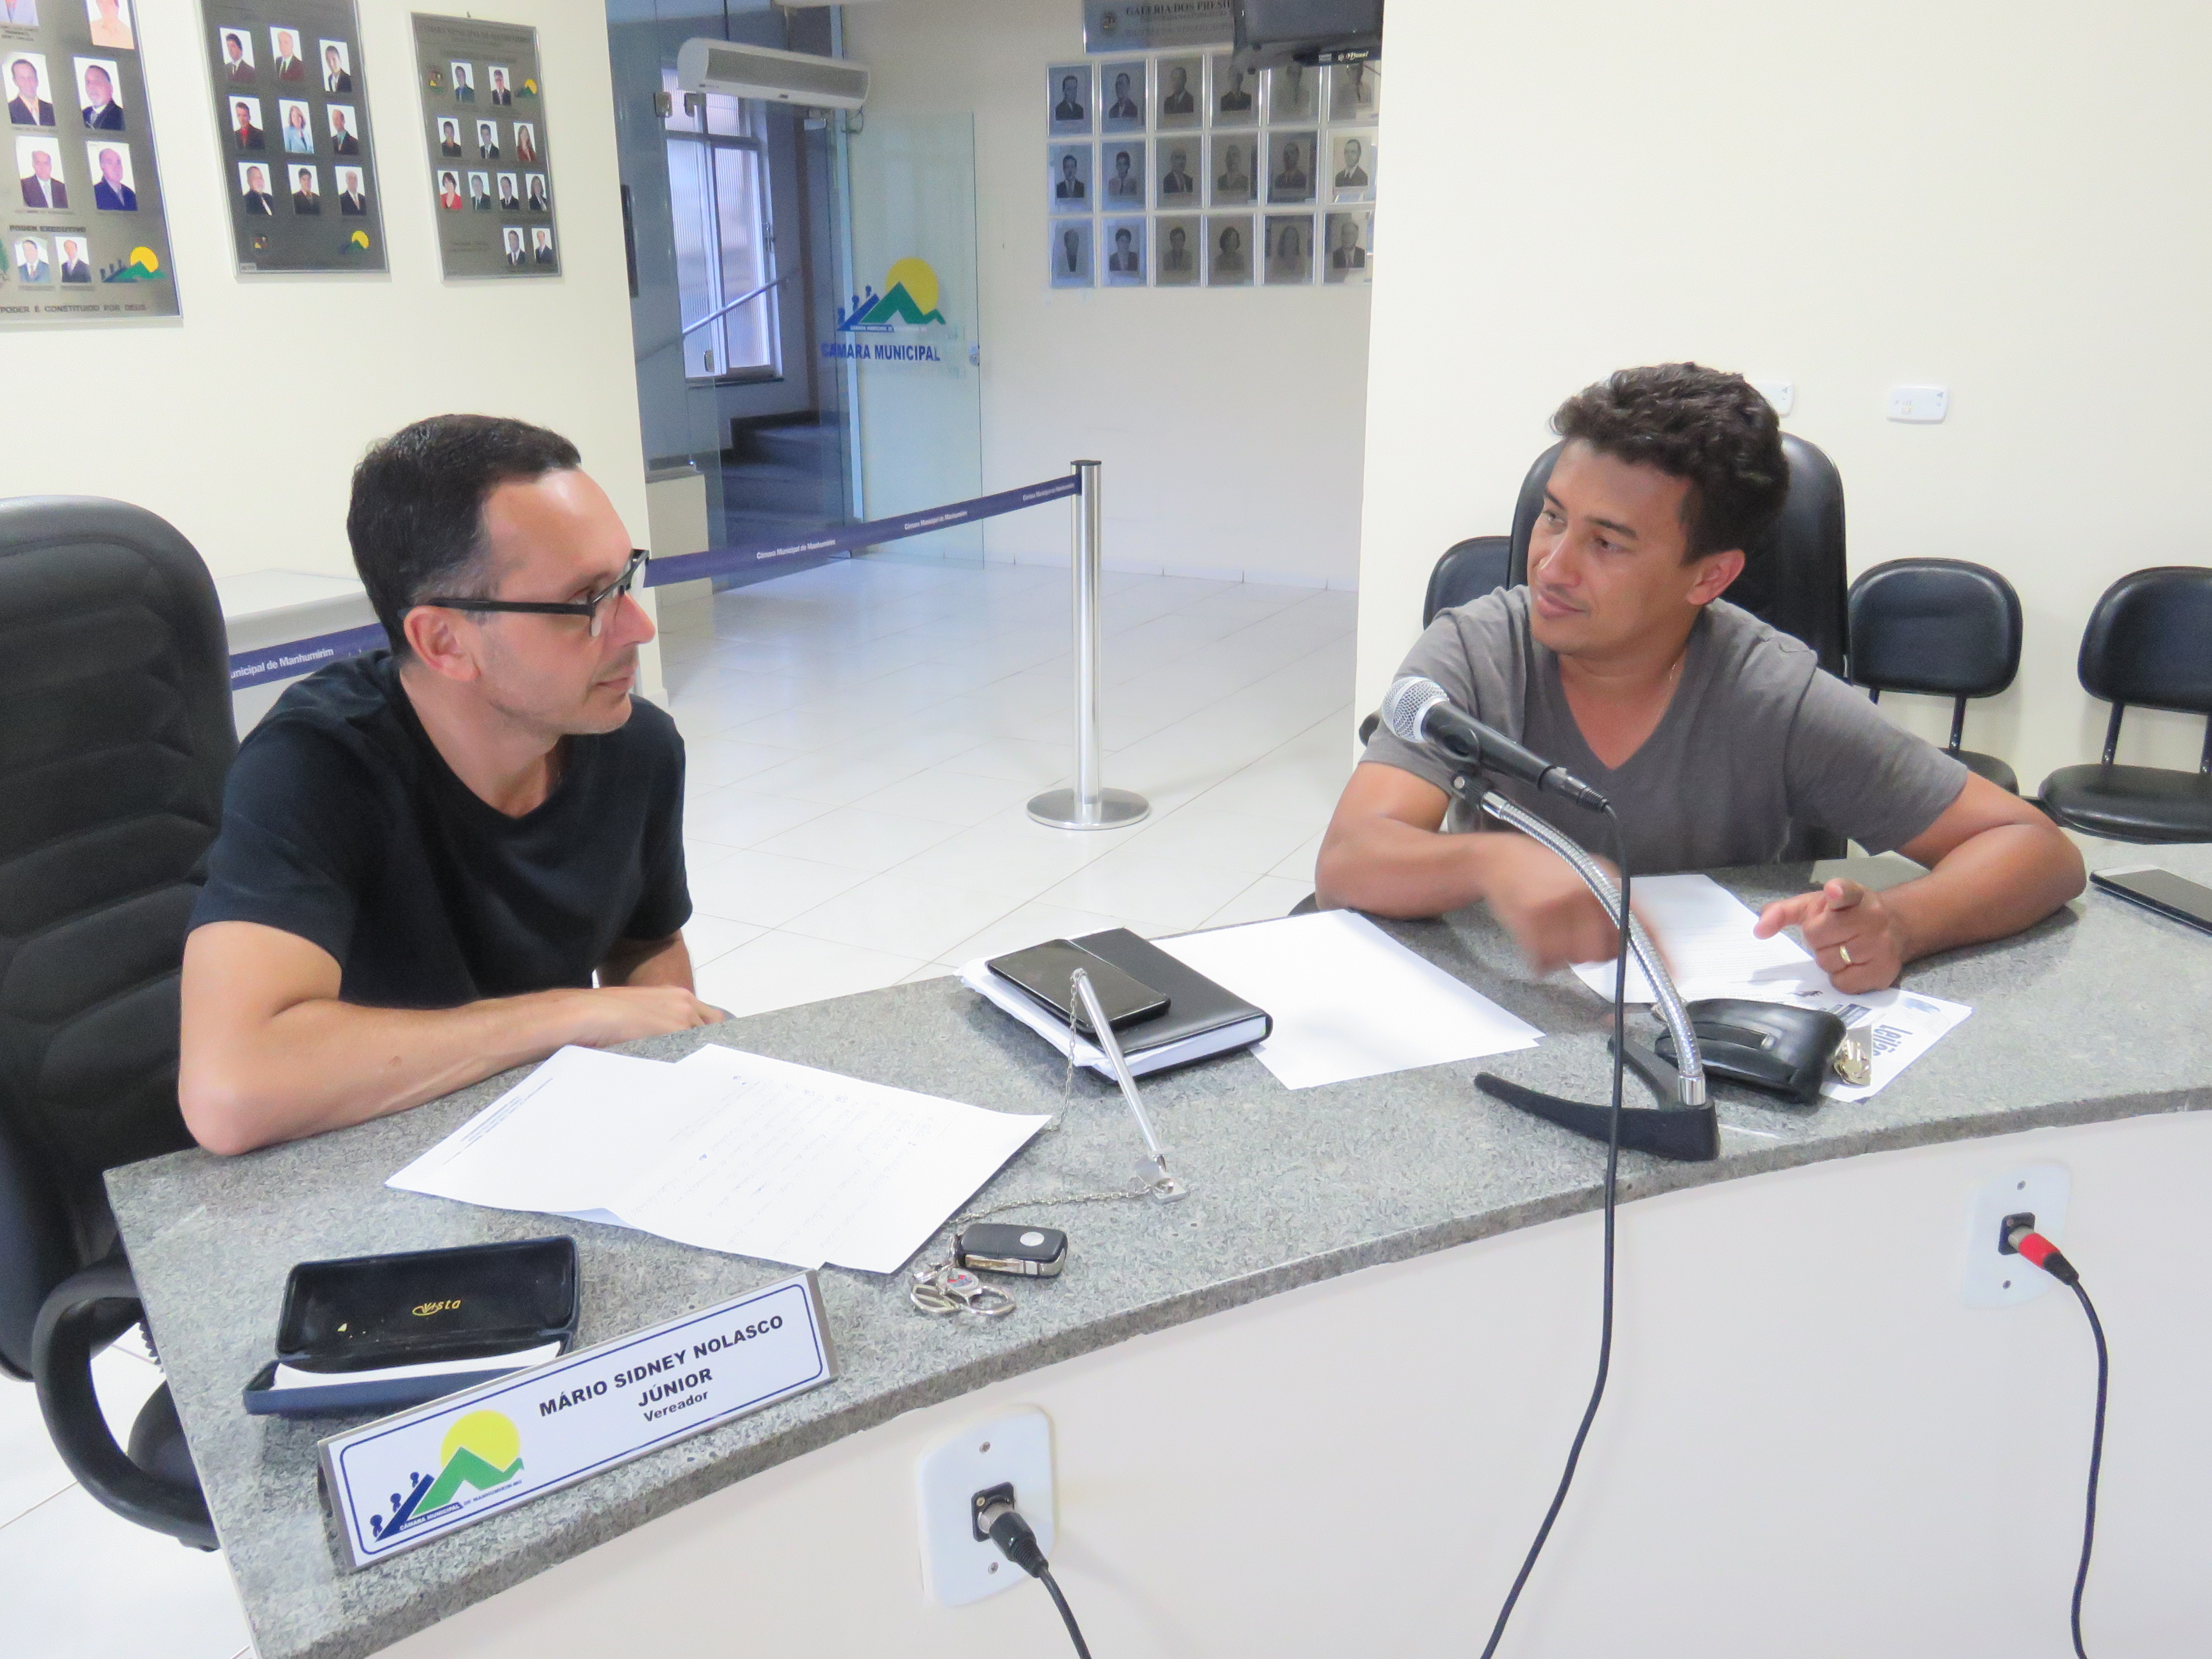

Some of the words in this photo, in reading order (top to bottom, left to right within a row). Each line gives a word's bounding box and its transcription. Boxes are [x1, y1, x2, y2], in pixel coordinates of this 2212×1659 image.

[875, 344, 941, 361] MUNICIPAL
[266, 660, 278, 670] de
[279, 648, 334, 667] Manhumirim
[539, 1381, 608, 1417] MÁRIO
[614, 1349, 686, 1388] SIDNEY
[693, 1315, 783, 1359] NOLASCO
[638, 1368, 713, 1407] JÚNIOR
[643, 1391, 709, 1422] Vereador
